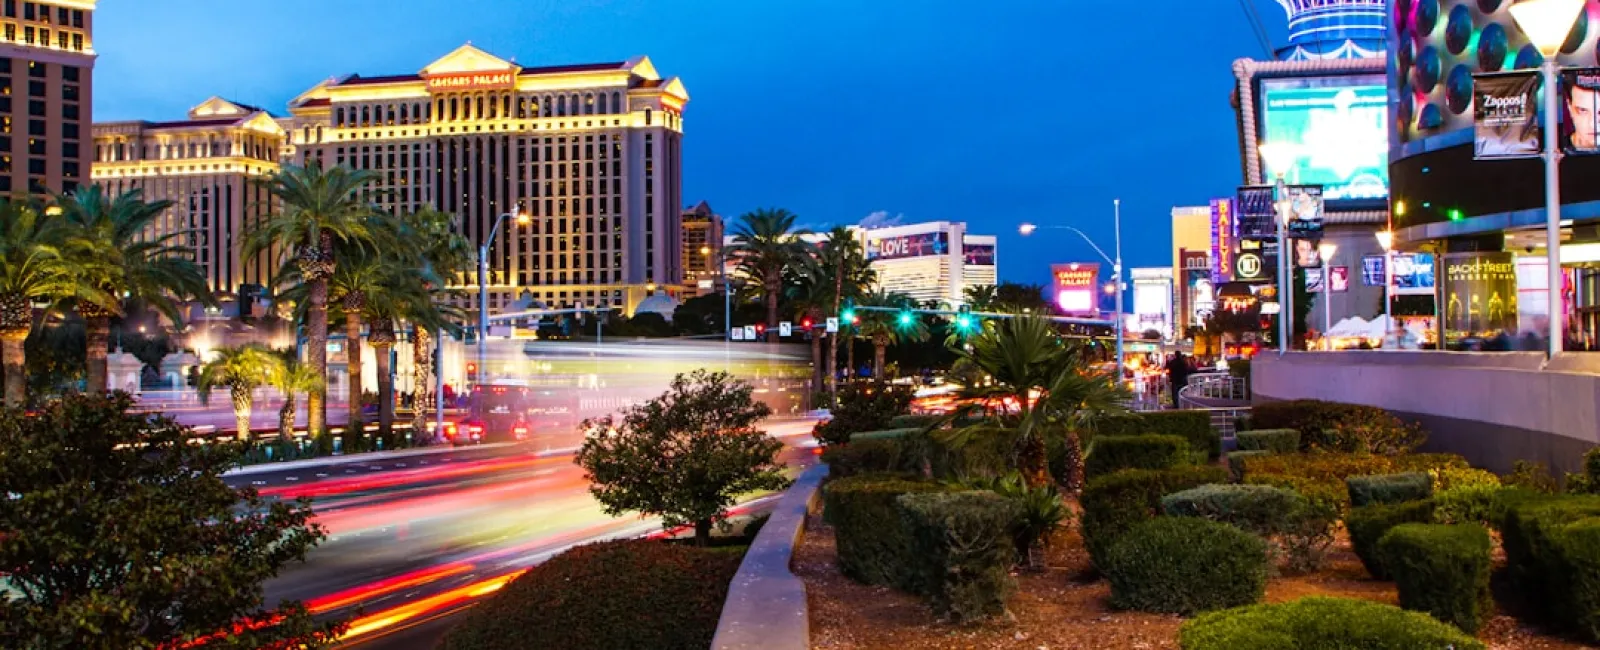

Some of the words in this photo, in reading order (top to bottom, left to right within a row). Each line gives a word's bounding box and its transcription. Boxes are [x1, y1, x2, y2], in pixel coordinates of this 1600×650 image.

[429, 76, 470, 87] CAESARS
[473, 74, 511, 85] PALACE
[880, 237, 909, 256] LOVE
